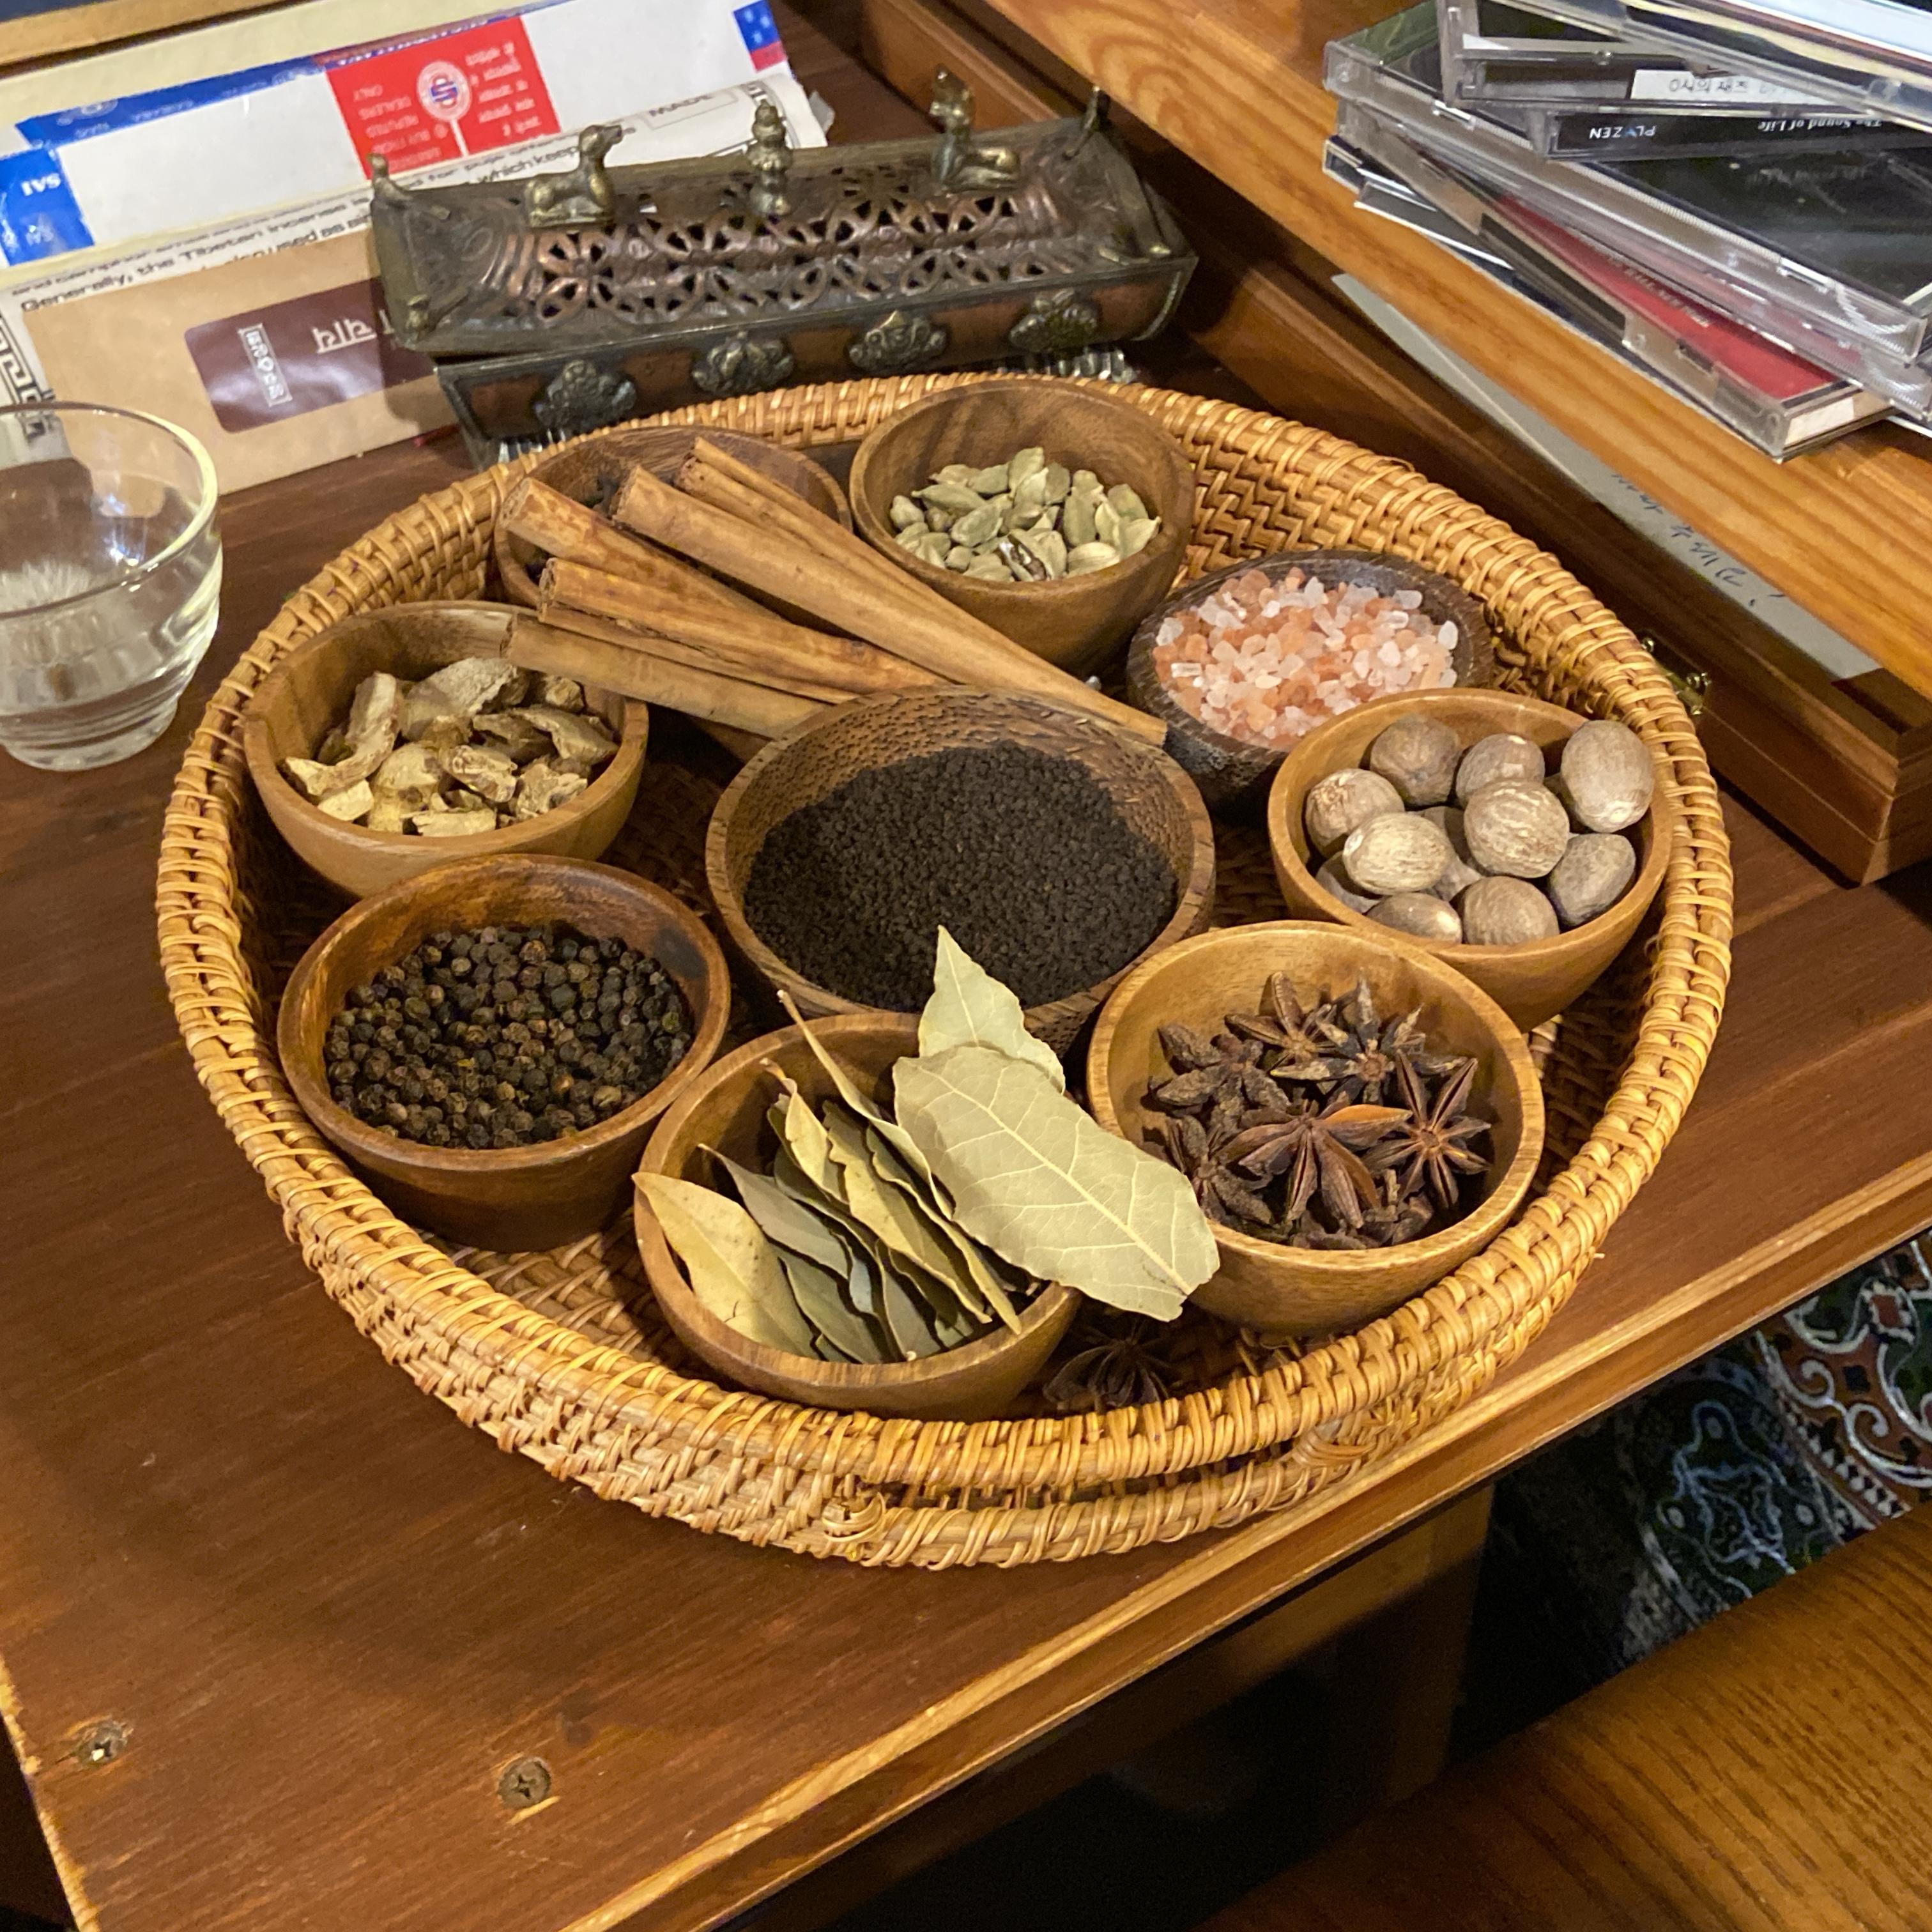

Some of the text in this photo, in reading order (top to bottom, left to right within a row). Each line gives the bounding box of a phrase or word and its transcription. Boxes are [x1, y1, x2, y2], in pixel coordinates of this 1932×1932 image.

[358, 95, 412, 120] DEALERS
[365, 114, 420, 139] REPUTED
[1758, 119, 1786, 132] Life
[1788, 118, 1805, 131] of
[1807, 118, 1851, 129] Sound
[21, 172, 61, 197] SAI
[21, 273, 133, 312] Generally,
[137, 257, 175, 273] the
[179, 231, 263, 260] Tibetan
[267, 204, 348, 233] incense
[312, 318, 378, 355] चाय
